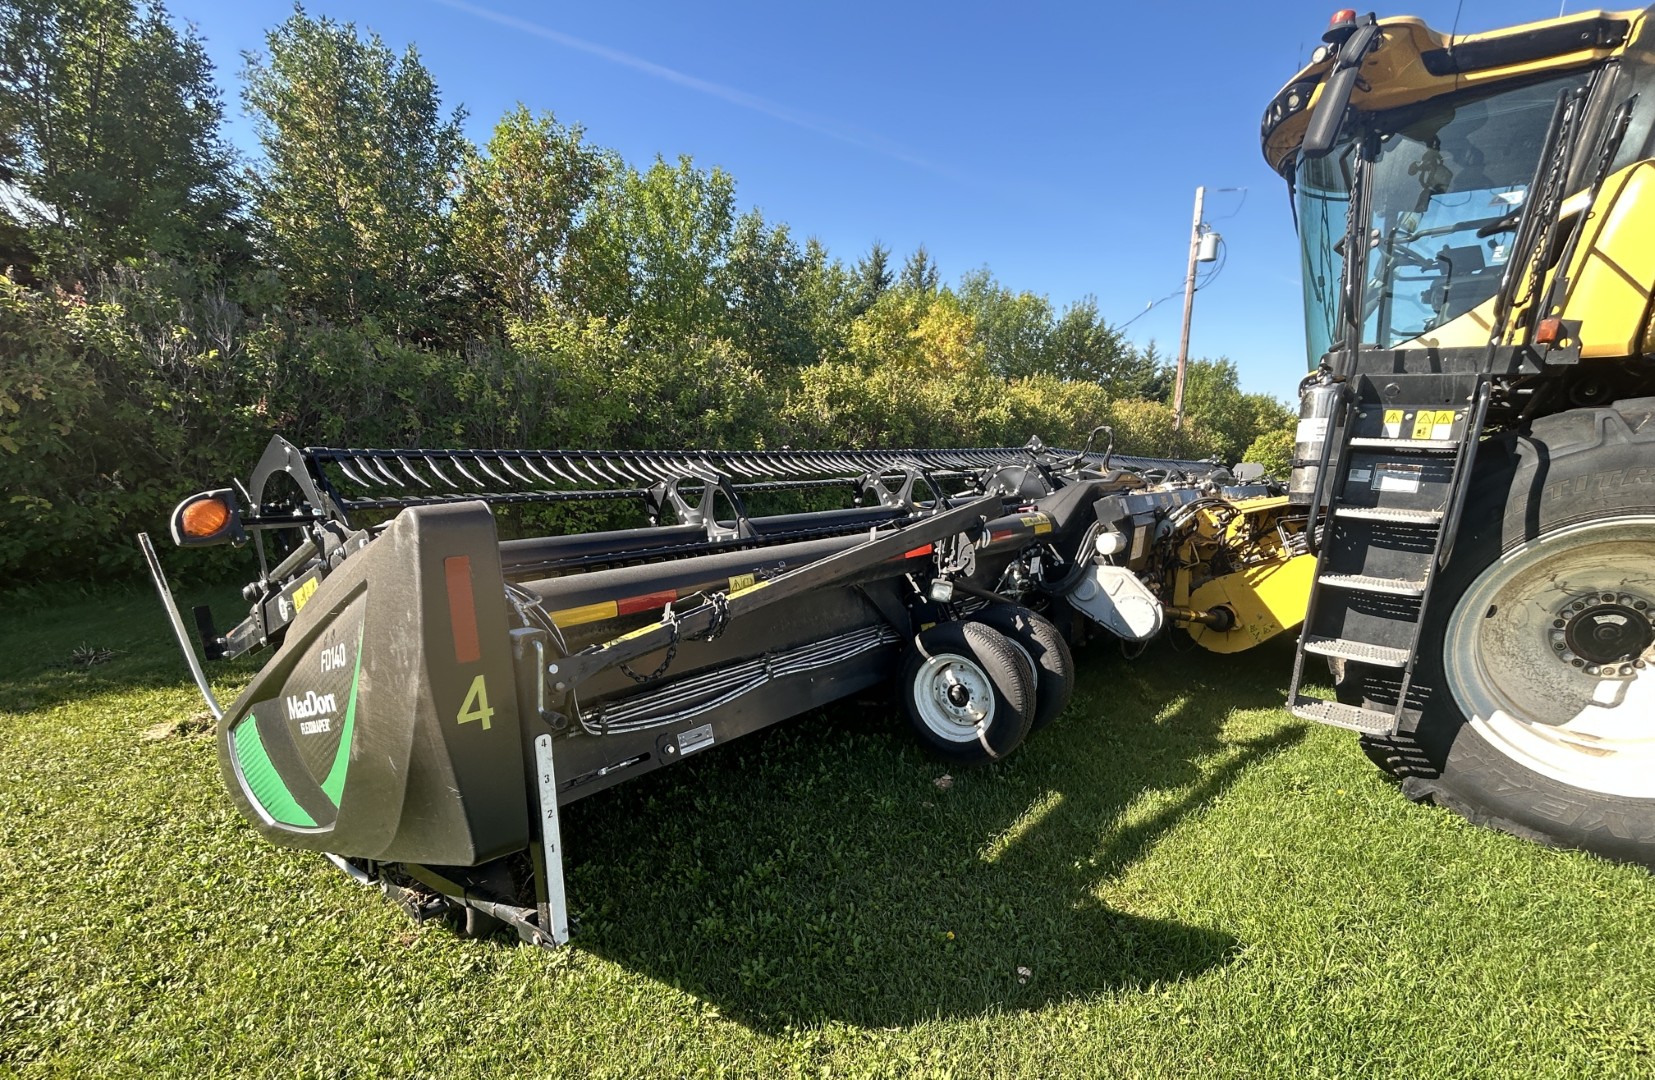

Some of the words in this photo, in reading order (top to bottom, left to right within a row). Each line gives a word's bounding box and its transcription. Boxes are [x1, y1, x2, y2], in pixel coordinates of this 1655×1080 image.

[320, 643, 346, 673] FD140
[286, 690, 337, 720] MacDon
[456, 674, 495, 730] 4
[540, 738, 548, 748] 4
[544, 774, 550, 784] 3
[547, 809, 553, 819] 2
[550, 843, 555, 852] 1
